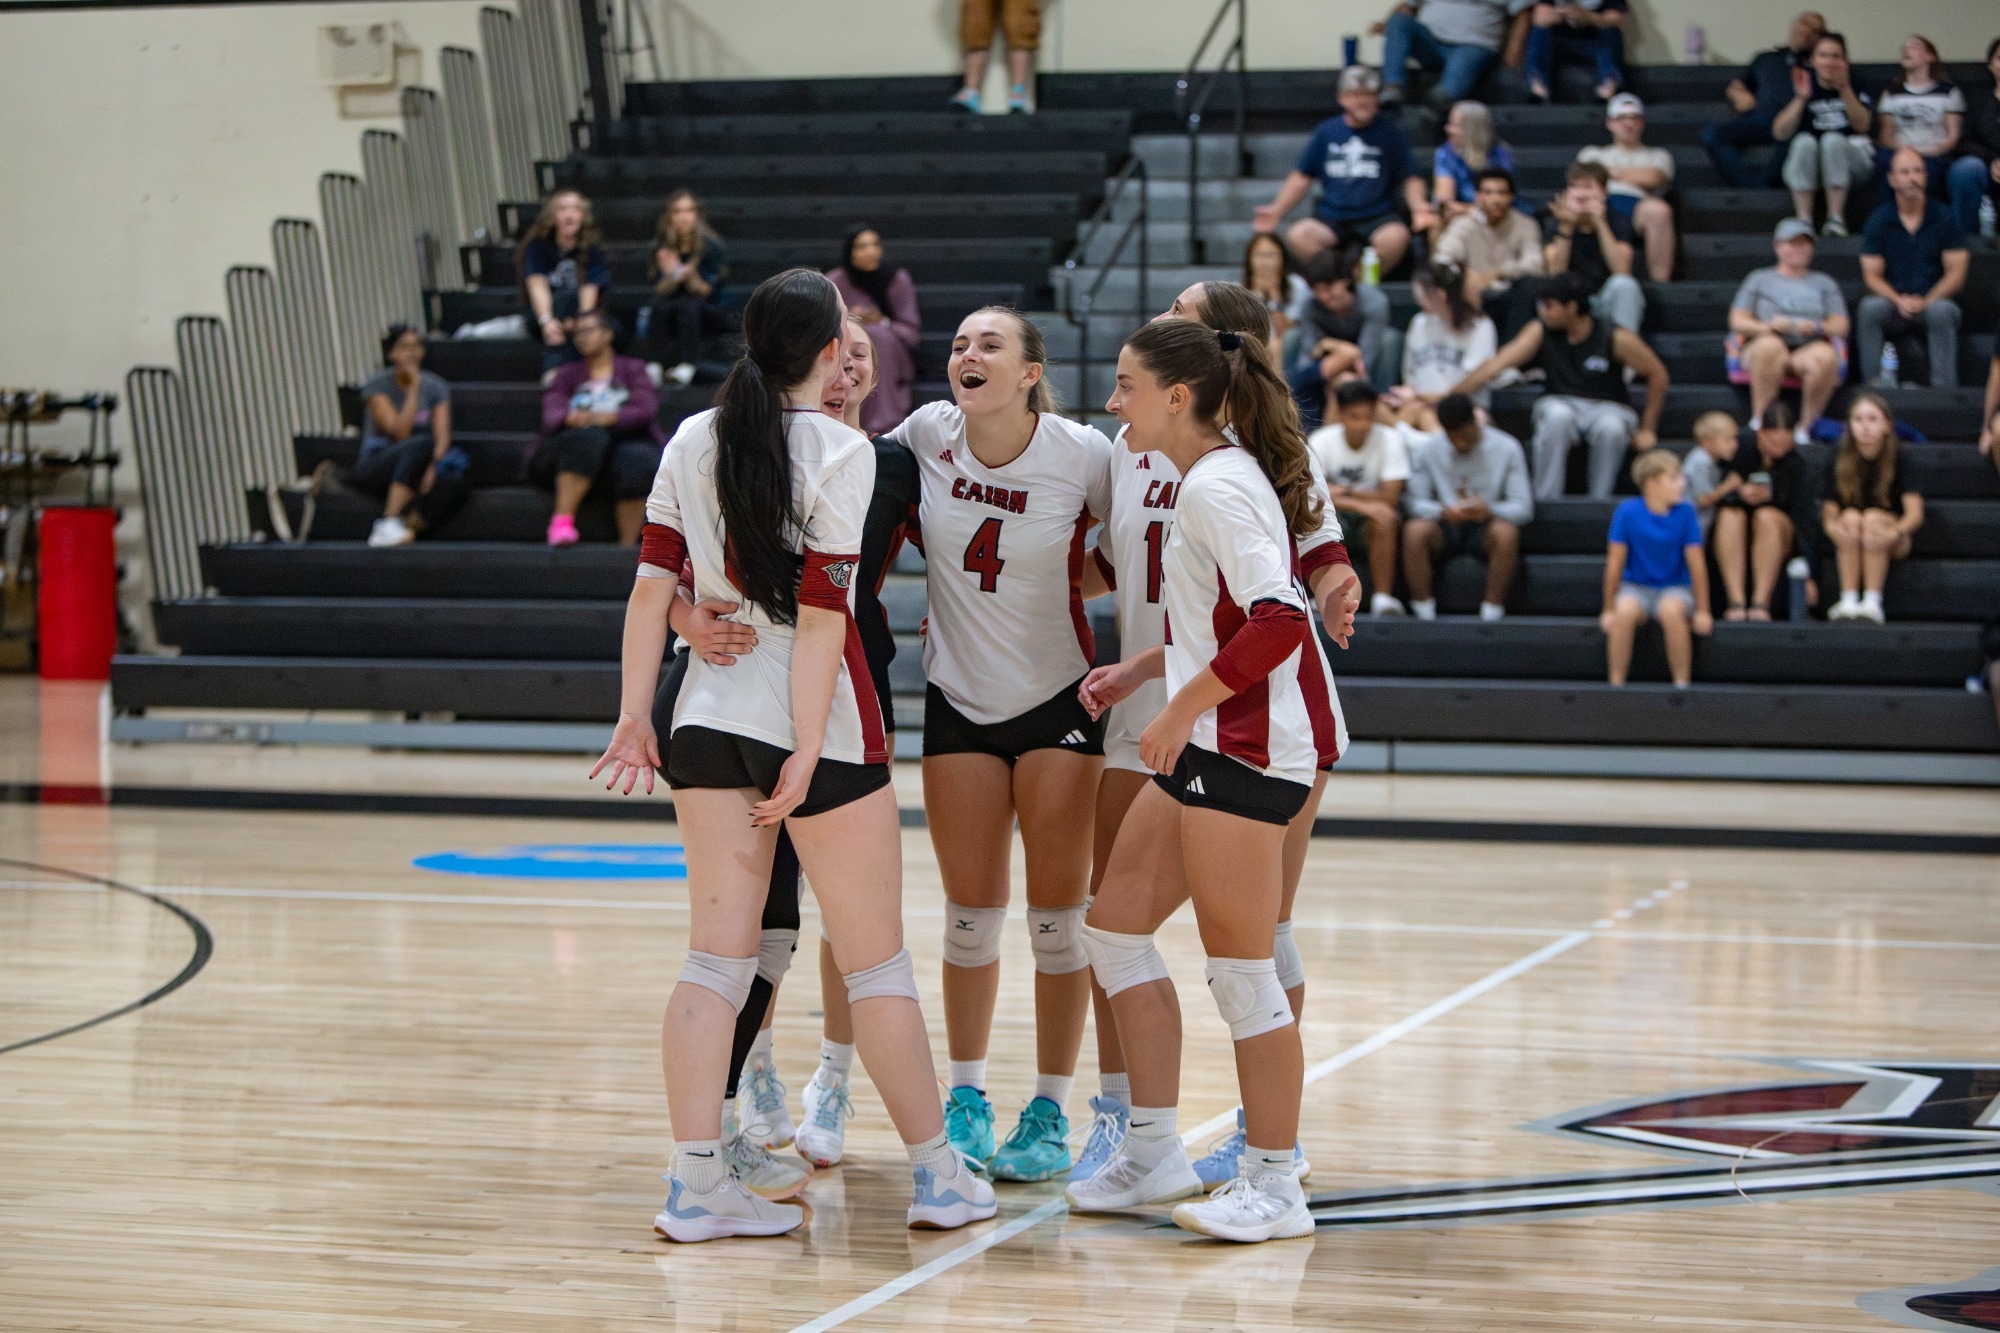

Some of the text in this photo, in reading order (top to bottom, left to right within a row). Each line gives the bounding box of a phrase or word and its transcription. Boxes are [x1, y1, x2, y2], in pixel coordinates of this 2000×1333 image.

[951, 477, 1028, 514] CAIRN
[963, 517, 1005, 593] 4
[1144, 520, 1174, 604] 1
